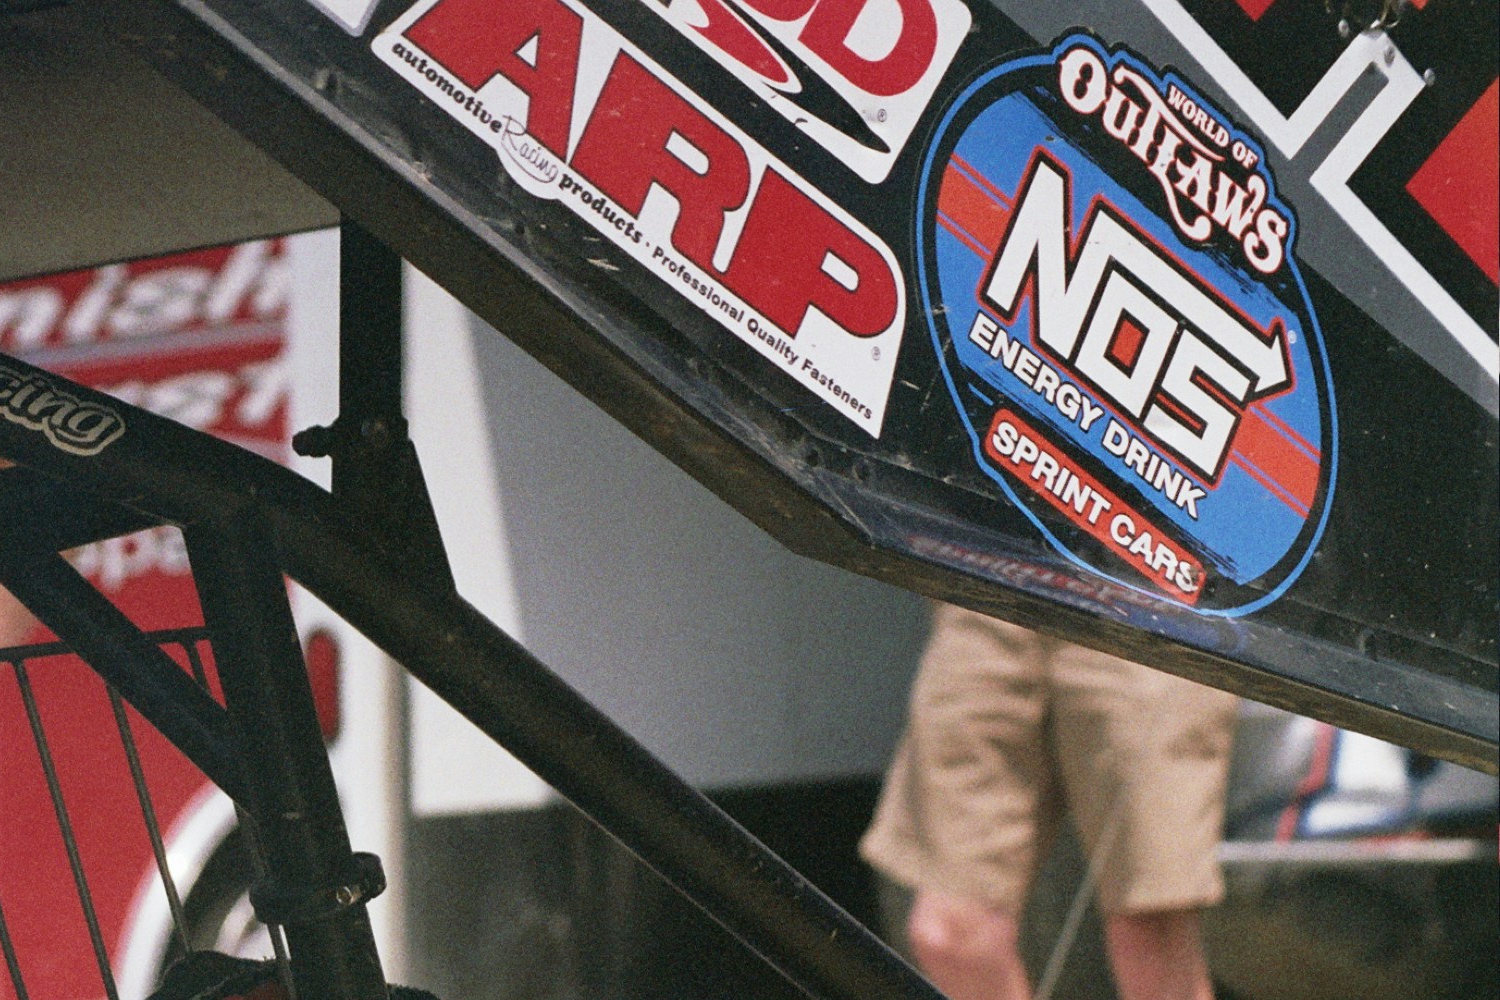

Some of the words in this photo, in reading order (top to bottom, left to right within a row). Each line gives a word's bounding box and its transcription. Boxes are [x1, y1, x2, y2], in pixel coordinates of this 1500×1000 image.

[392, 42, 502, 133] automotive
[500, 113, 560, 184] Racing
[558, 171, 643, 244] products
[652, 245, 746, 323] Professional
[746, 317, 800, 365] Quality
[801, 357, 873, 420] Fasteners
[401, 0, 899, 338] ARP
[1167, 83, 1230, 148] WORLD
[1231, 140, 1260, 169] OF
[968, 312, 1104, 432] ENERGY
[1102, 419, 1206, 518] DRINK
[986, 160, 1290, 478] NOS
[992, 421, 1112, 525] SPRINT
[1110, 513, 1199, 593] CARS
